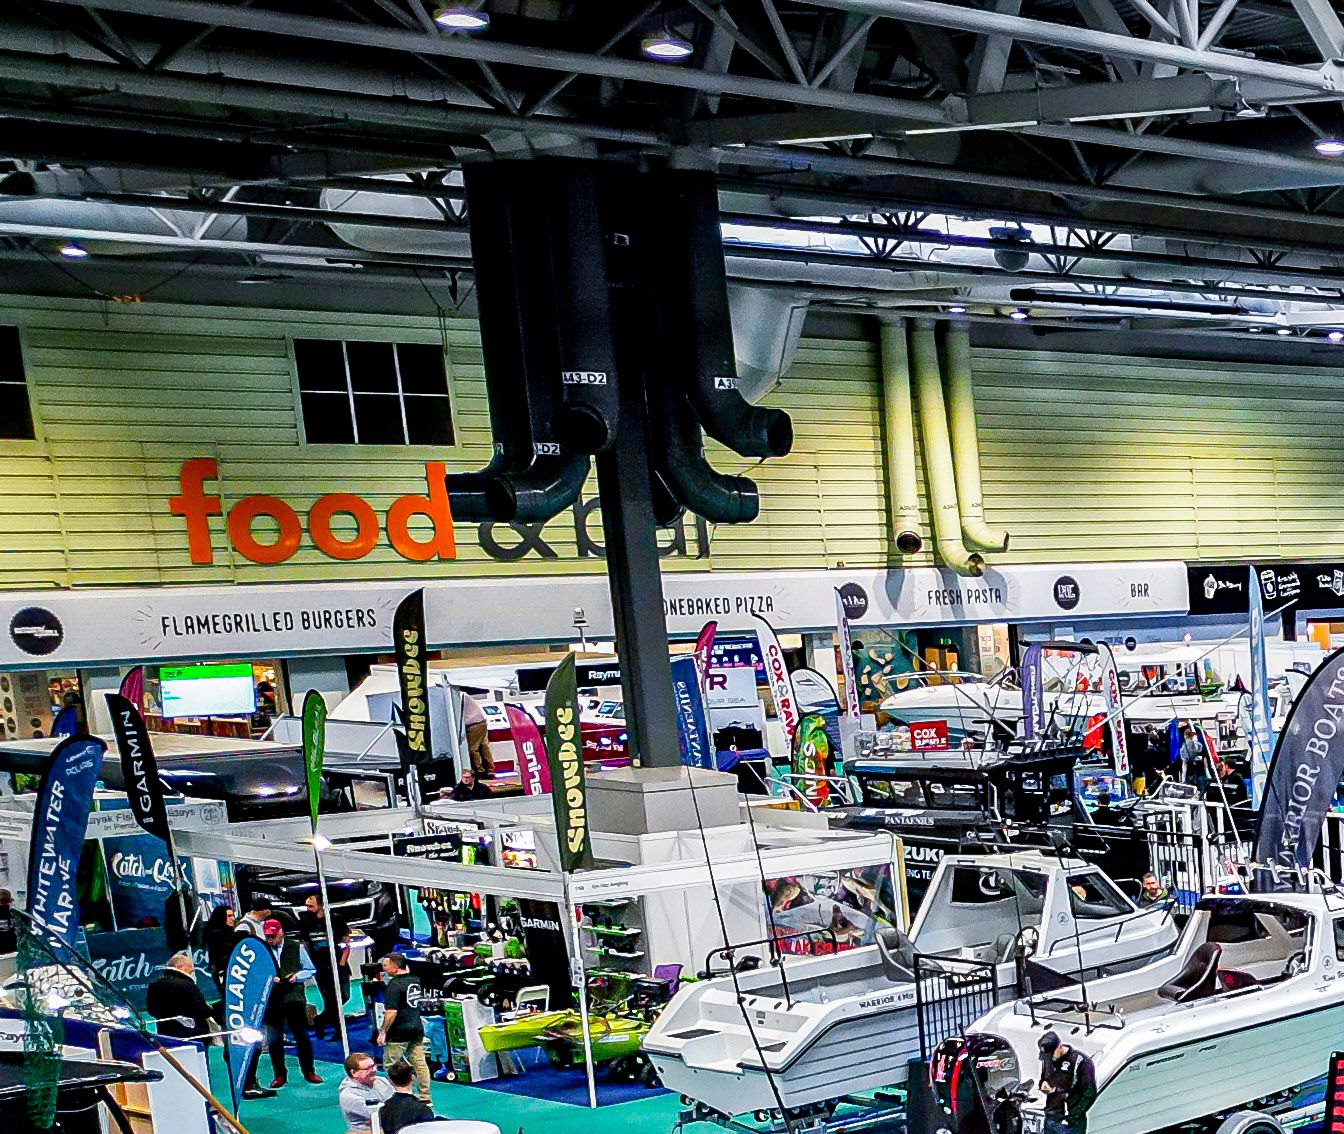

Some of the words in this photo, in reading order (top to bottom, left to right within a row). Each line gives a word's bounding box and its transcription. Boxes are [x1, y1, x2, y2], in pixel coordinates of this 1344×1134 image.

[170, 457, 458, 564] food
[927, 589, 962, 607] FRESH
[967, 588, 1001, 605] PASTA
[1130, 582, 1150, 599] BAR
[736, 595, 774, 614] PIZZA
[162, 612, 294, 637] FLAMEGRILLED
[301, 608, 377, 631] BURGERS
[768, 644, 785, 684] COX
[913, 728, 937, 740] COX
[121, 710, 153, 813] GARMIN
[521, 916, 560, 932] GARMIN
